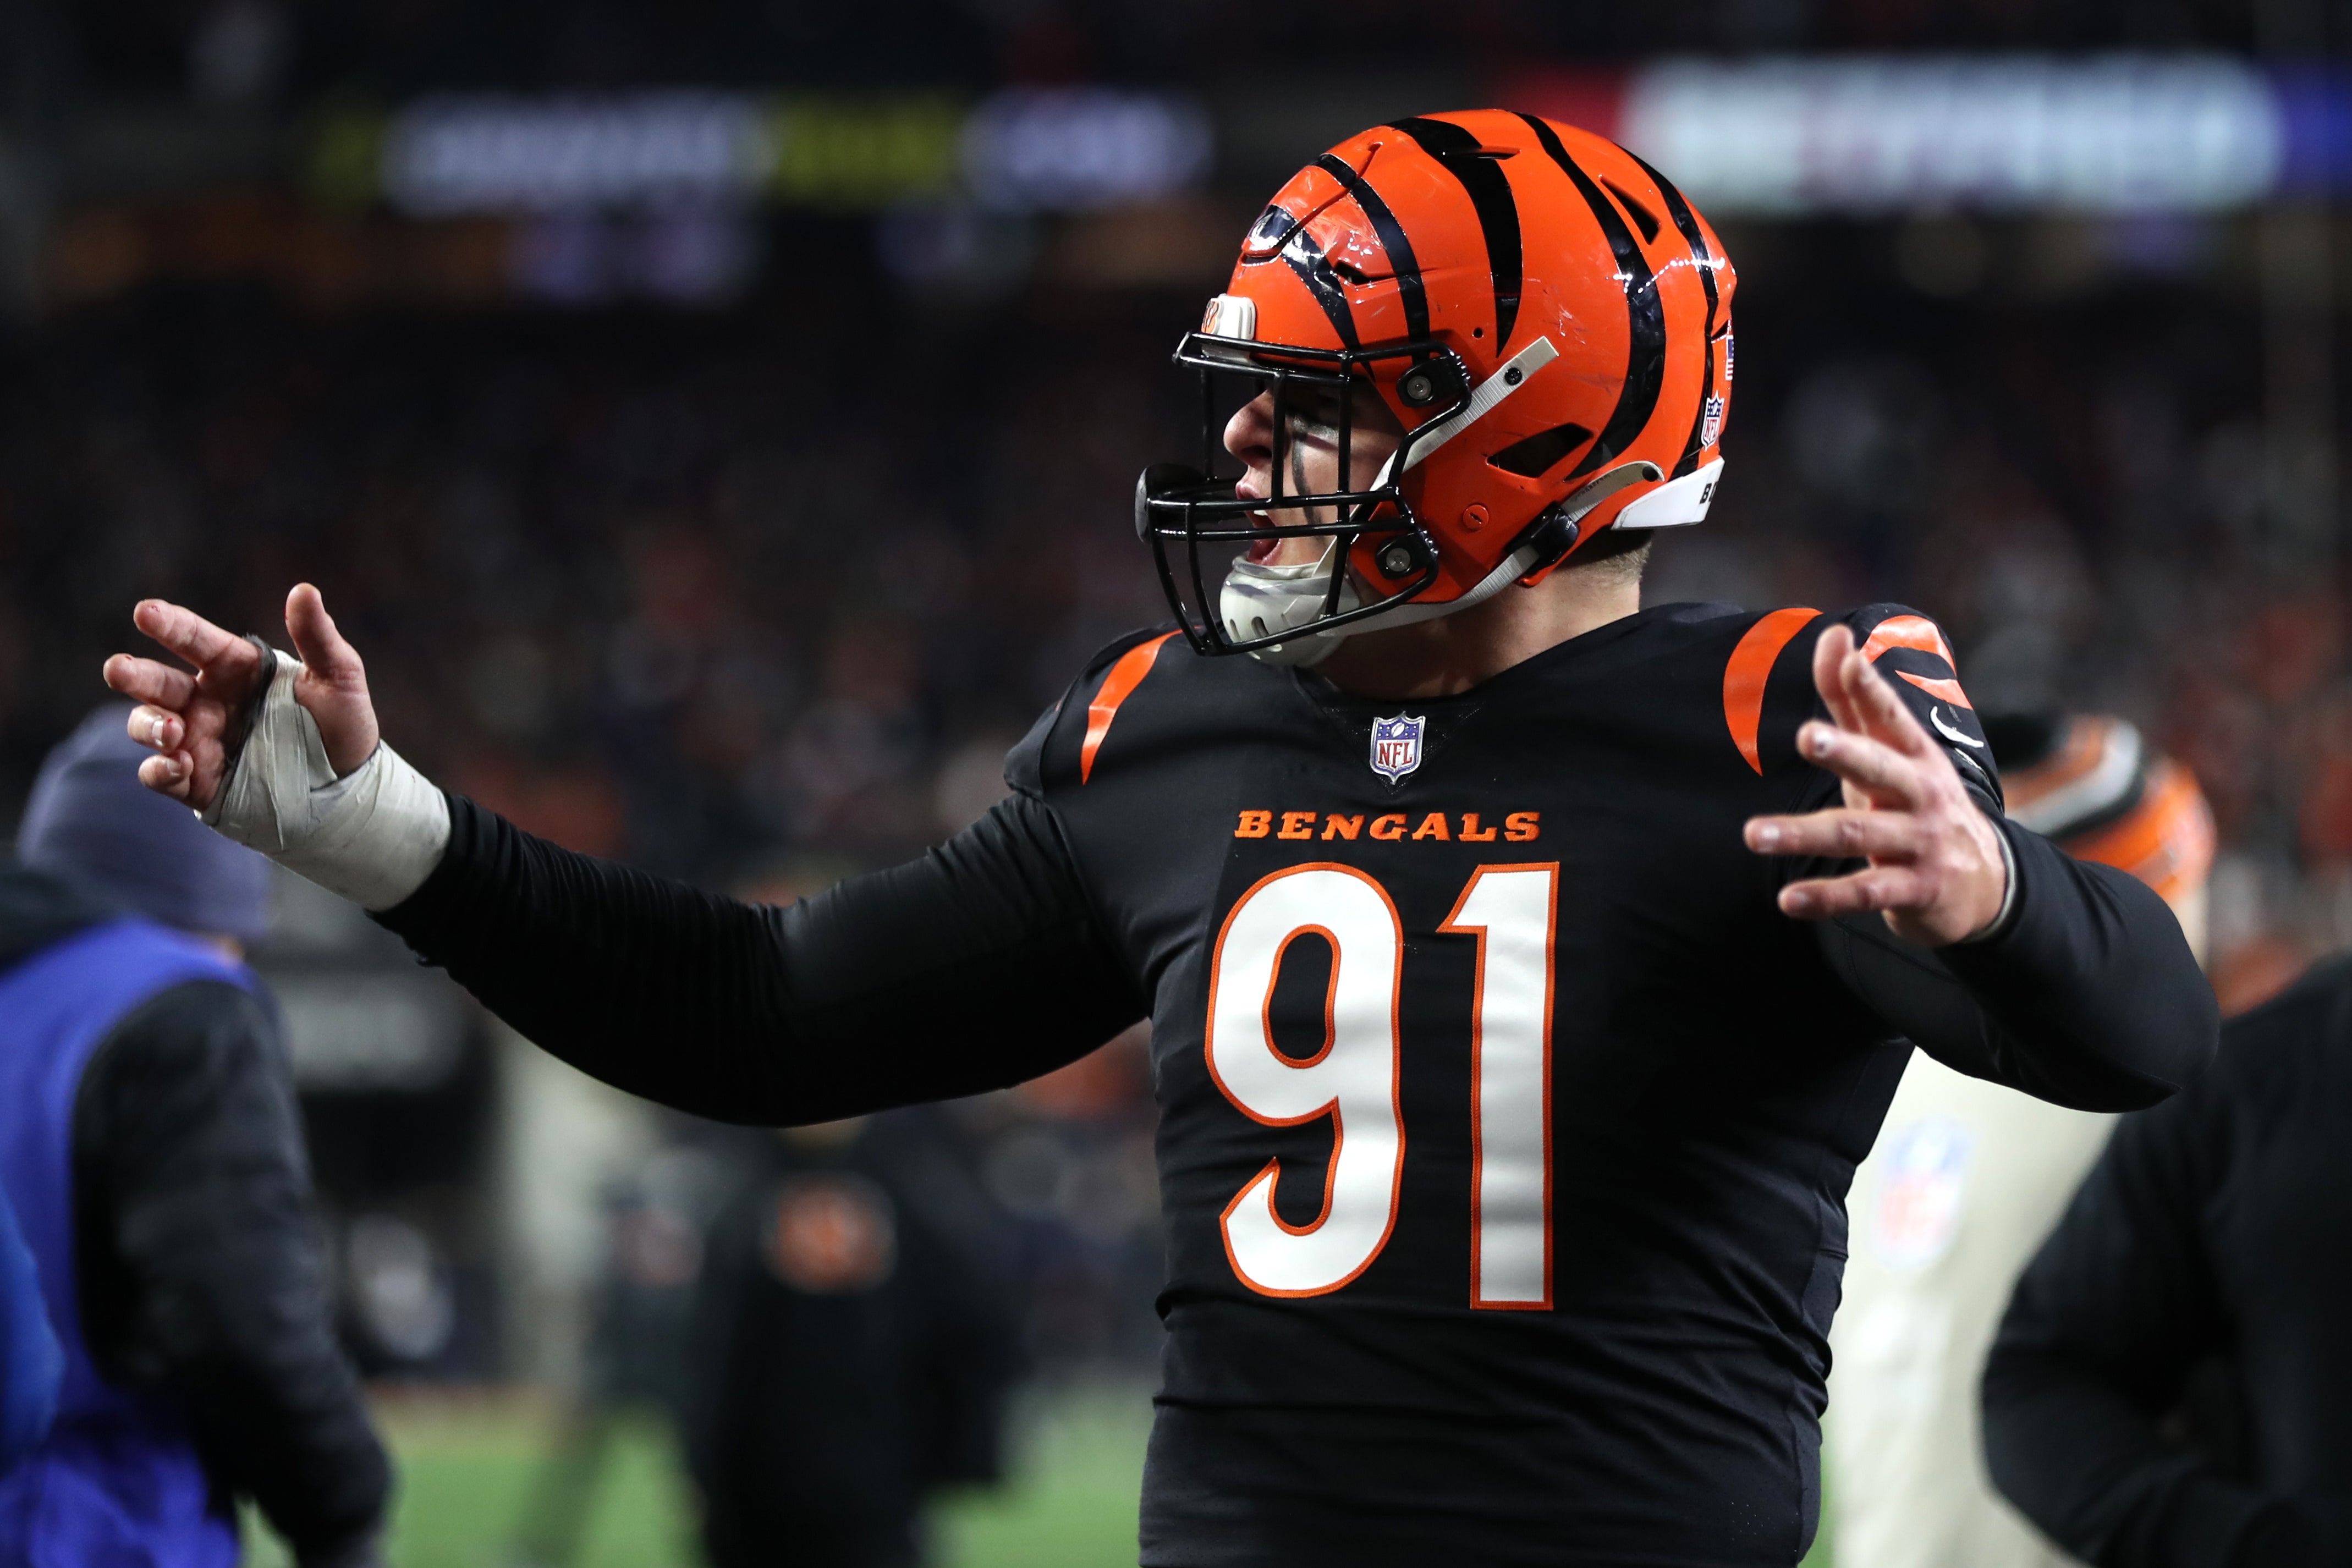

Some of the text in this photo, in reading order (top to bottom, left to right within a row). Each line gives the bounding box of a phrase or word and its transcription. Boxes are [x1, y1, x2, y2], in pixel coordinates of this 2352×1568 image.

[1377, 742, 1413, 769] NFL
[1234, 810, 1541, 841] BENGALS
[1204, 861, 1559, 1311] 91
